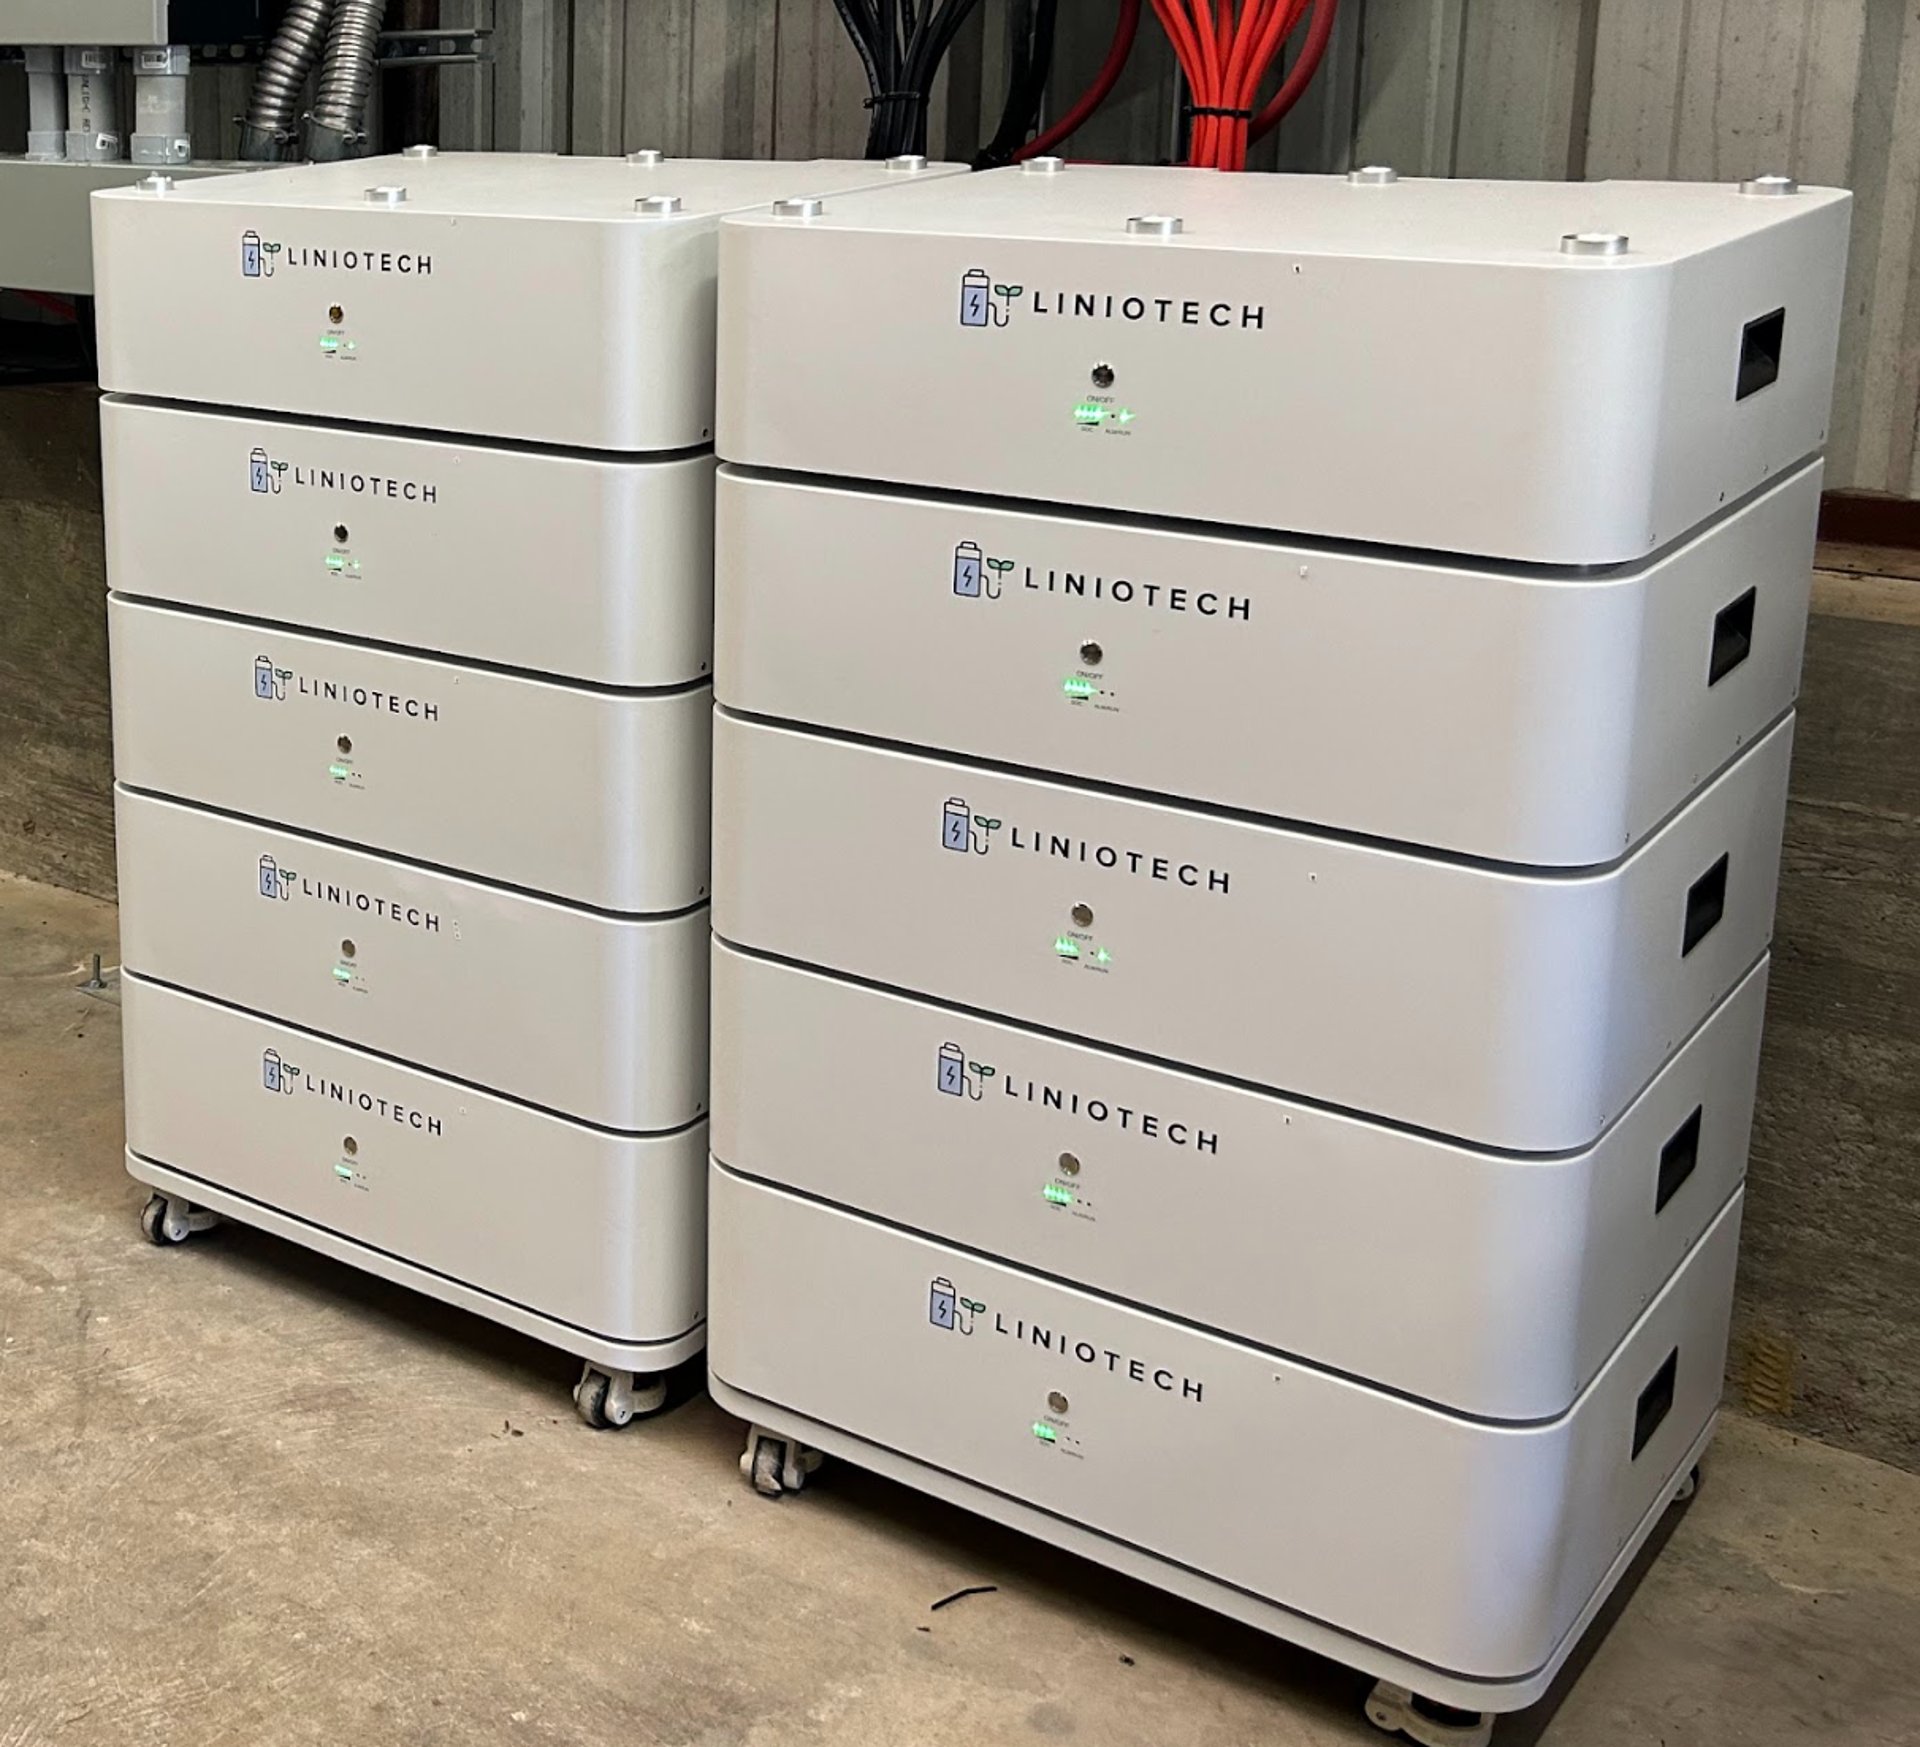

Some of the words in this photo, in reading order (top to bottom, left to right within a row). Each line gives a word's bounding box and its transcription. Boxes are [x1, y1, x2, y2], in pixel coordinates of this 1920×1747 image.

[288, 247, 432, 275] LINIOTECH
[1034, 291, 1265, 330] LINIOTECH
[296, 467, 437, 504] LINIOTECH
[1025, 567, 1251, 622] LINIOTECH
[300, 677, 439, 722] LINIOTECH
[1012, 827, 1230, 894] LINIOTECH
[303, 878, 440, 932] LINIOTECH
[307, 1074, 443, 1137] LINIOTECH
[1006, 1076, 1219, 1155] LINIOTECH
[996, 1313, 1203, 1403] LINIOTECH
